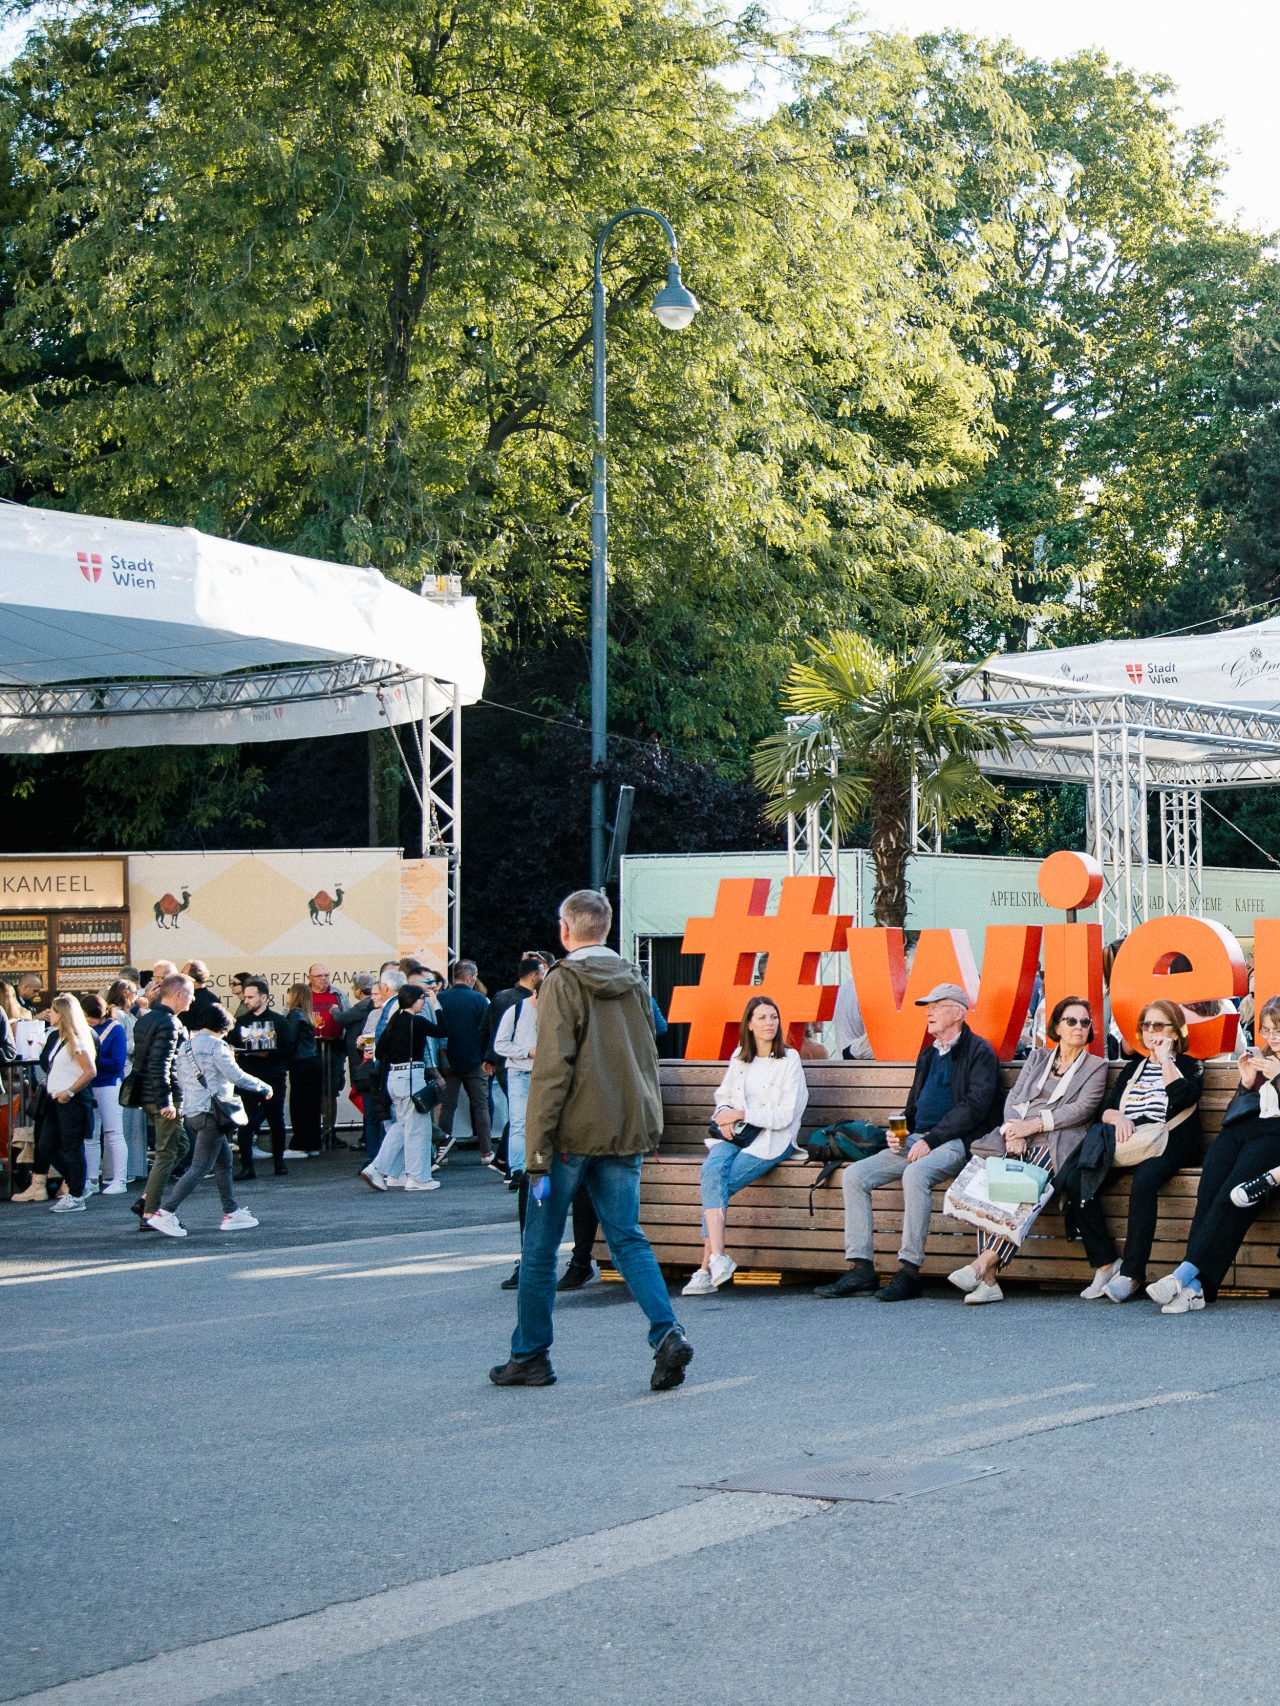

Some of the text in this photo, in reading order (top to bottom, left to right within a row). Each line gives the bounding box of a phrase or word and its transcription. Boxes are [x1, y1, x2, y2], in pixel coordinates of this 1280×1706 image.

[110, 555, 154, 572] Stadt
[112, 571, 156, 589] Wien
[1147, 663, 1177, 673] Stadt
[1148, 674, 1179, 685] Wien
[3, 875, 95, 893] KAMEEL
[1235, 898, 1266, 913] KAFFEE
